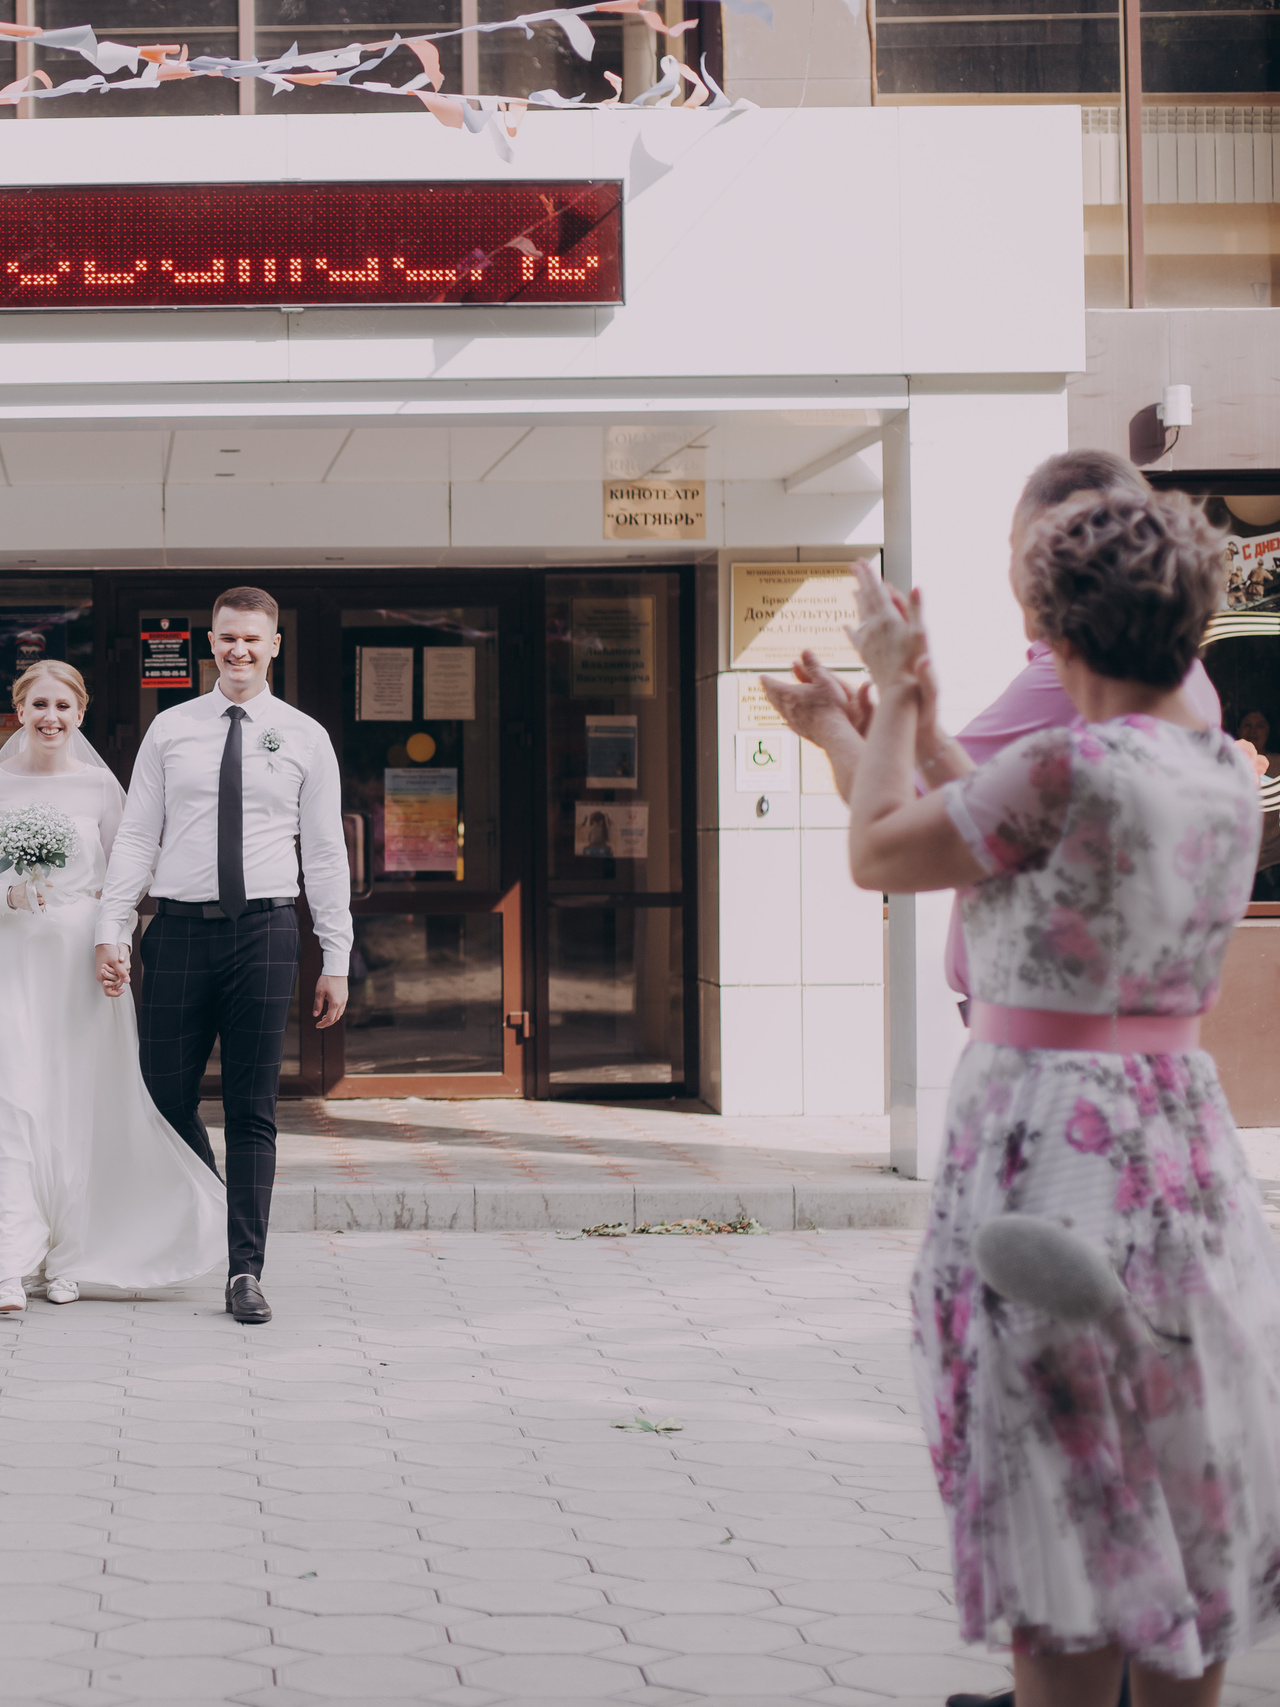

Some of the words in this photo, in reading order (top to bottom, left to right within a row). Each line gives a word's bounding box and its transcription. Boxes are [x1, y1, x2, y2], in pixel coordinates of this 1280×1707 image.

[609, 488, 700, 500] КИНОТЕАТР
[1242, 543, 1252, 560] С
[762, 595, 837, 606] Брюховецкий
[744, 607, 775, 622] Дом
[780, 609, 856, 621] культуры
